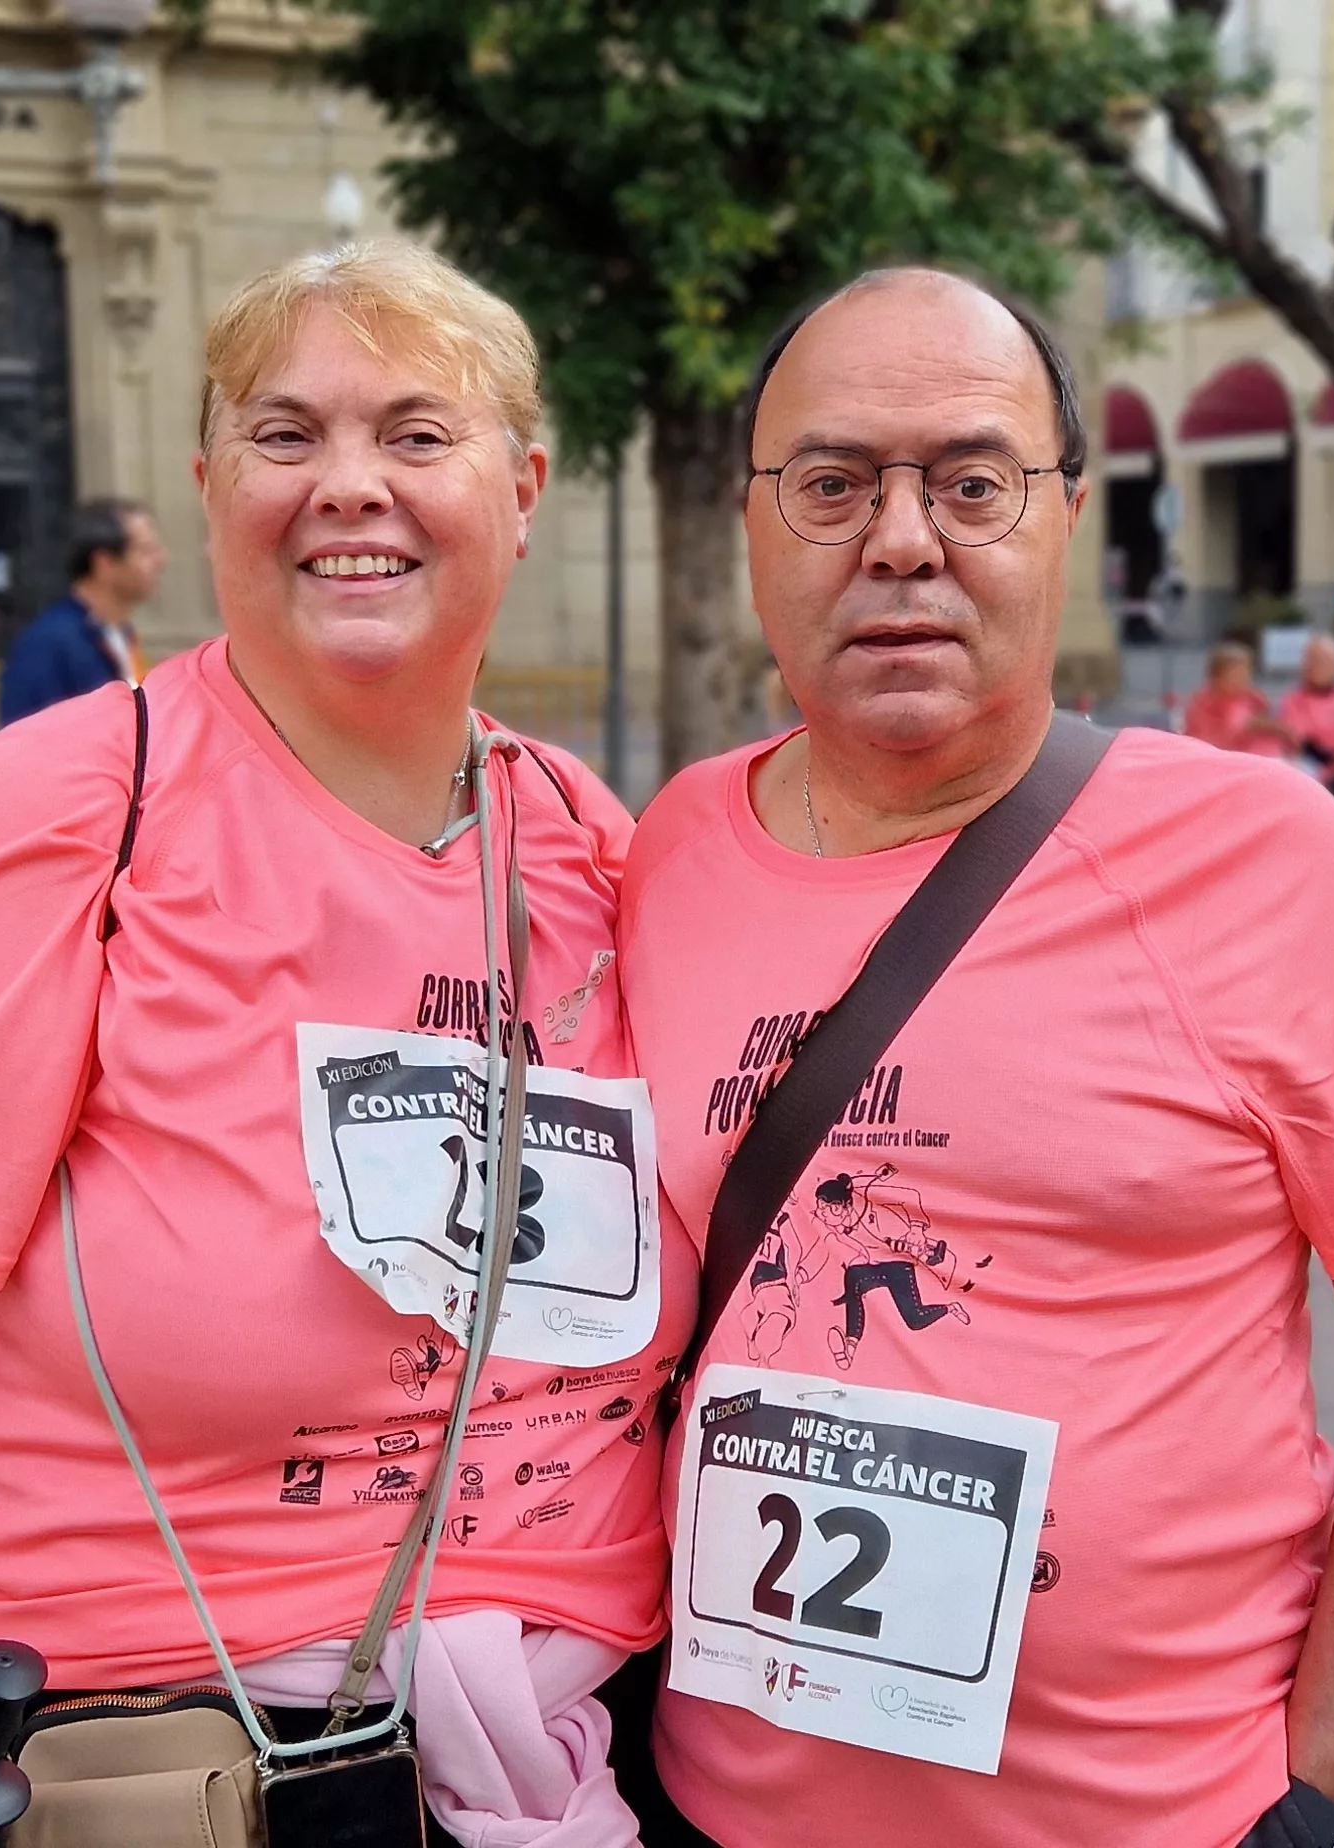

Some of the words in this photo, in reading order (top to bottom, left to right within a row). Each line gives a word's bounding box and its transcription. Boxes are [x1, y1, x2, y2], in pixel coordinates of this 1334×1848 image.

[325, 1070, 341, 1084] XI
[343, 1057, 394, 1082] EDICIÓN
[499, 1115, 618, 1158] ÁNCER
[866, 1130, 900, 1147] contra
[903, 1128, 912, 1147] el
[567, 1374, 591, 1387] hoya
[592, 1372, 605, 1382] de
[607, 1367, 640, 1379] huesca
[526, 1409, 586, 1428] URBAN
[705, 1407, 715, 1424] XI
[716, 1395, 755, 1420] EDICIÓN
[292, 1423, 359, 1438] Alcampo
[791, 1416, 876, 1452] HUESCA
[536, 1460, 571, 1476] walqa
[712, 1432, 801, 1474] CONTRA
[805, 1446, 841, 1481] EL
[852, 1454, 996, 1511] CÁNCER
[752, 1492, 891, 1640] 22
